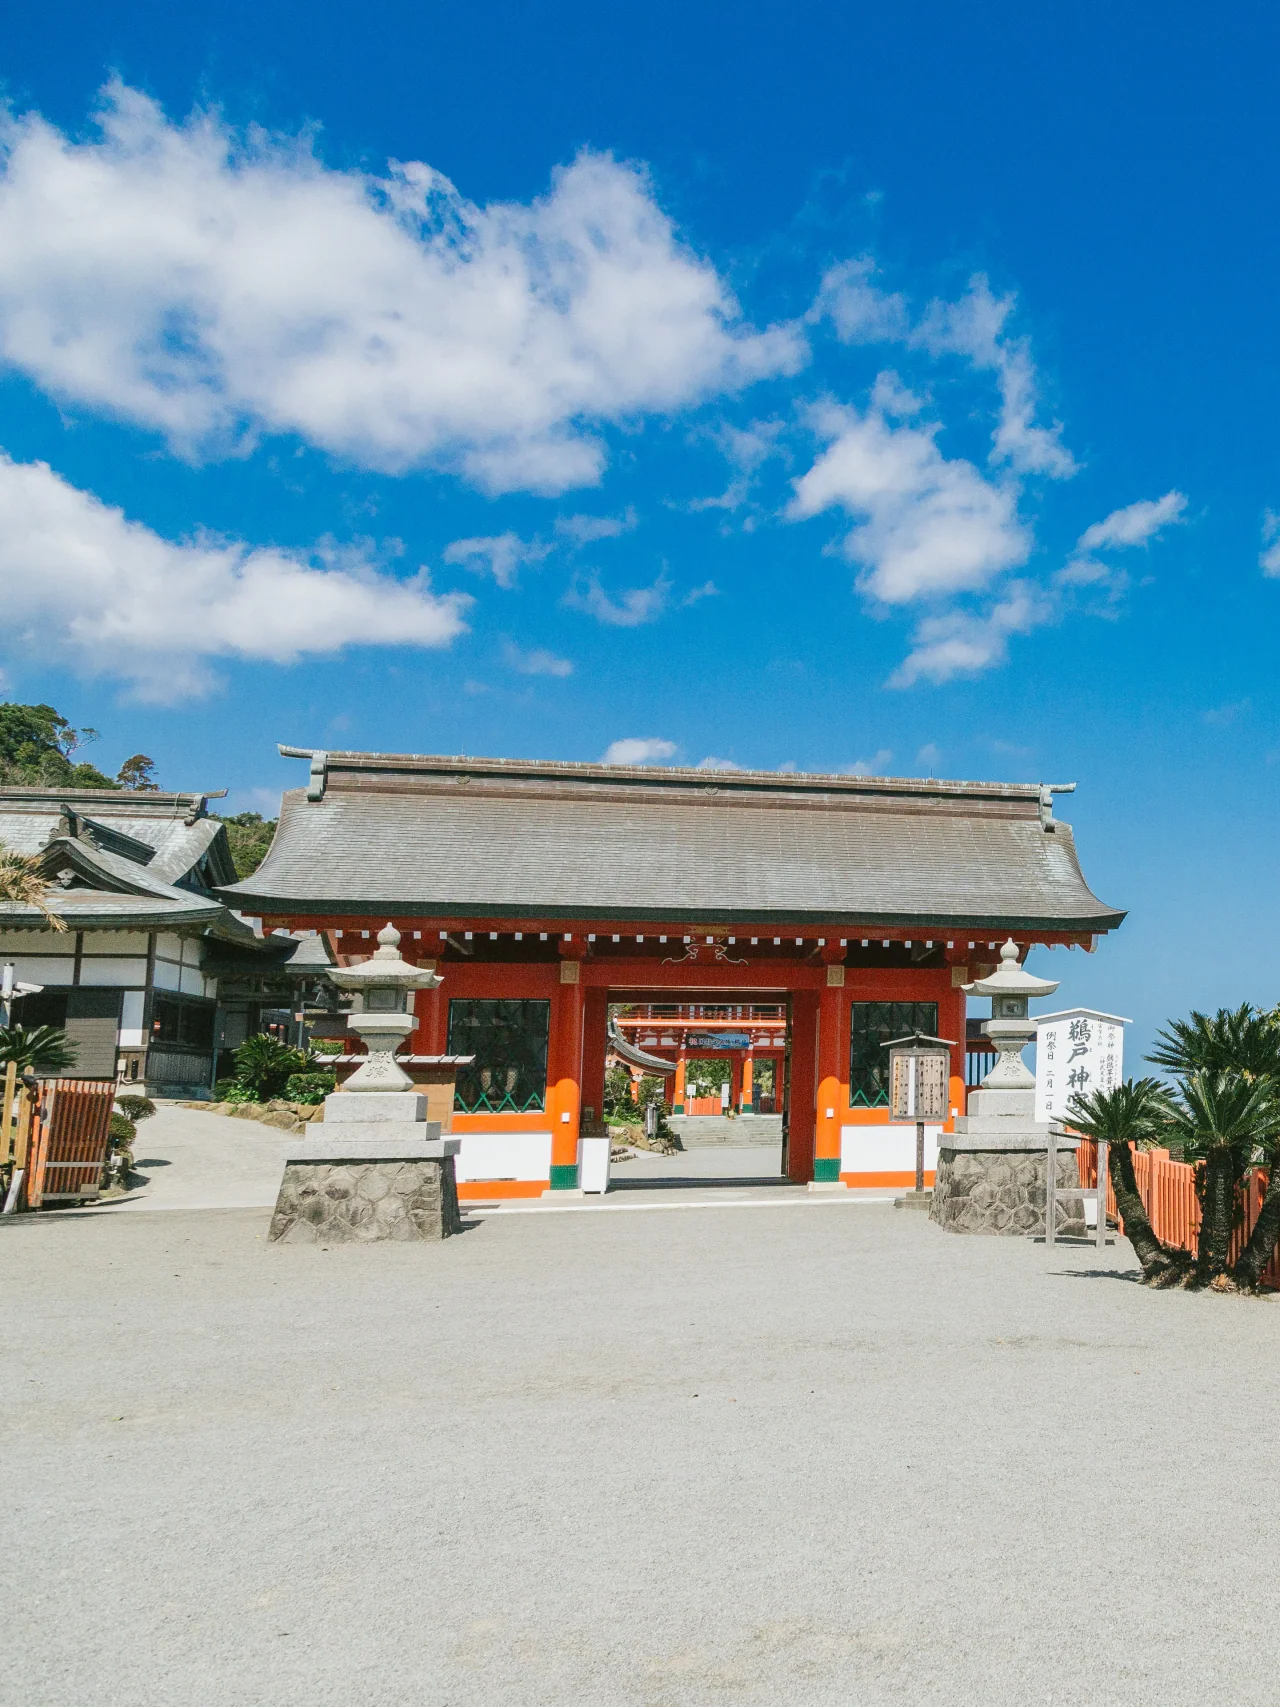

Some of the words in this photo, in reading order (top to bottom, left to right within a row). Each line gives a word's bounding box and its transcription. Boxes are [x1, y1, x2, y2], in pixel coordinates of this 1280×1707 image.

[1046, 1031, 1057, 1060] 例祭日
[1045, 1070, 1055, 1111] 二月一日
